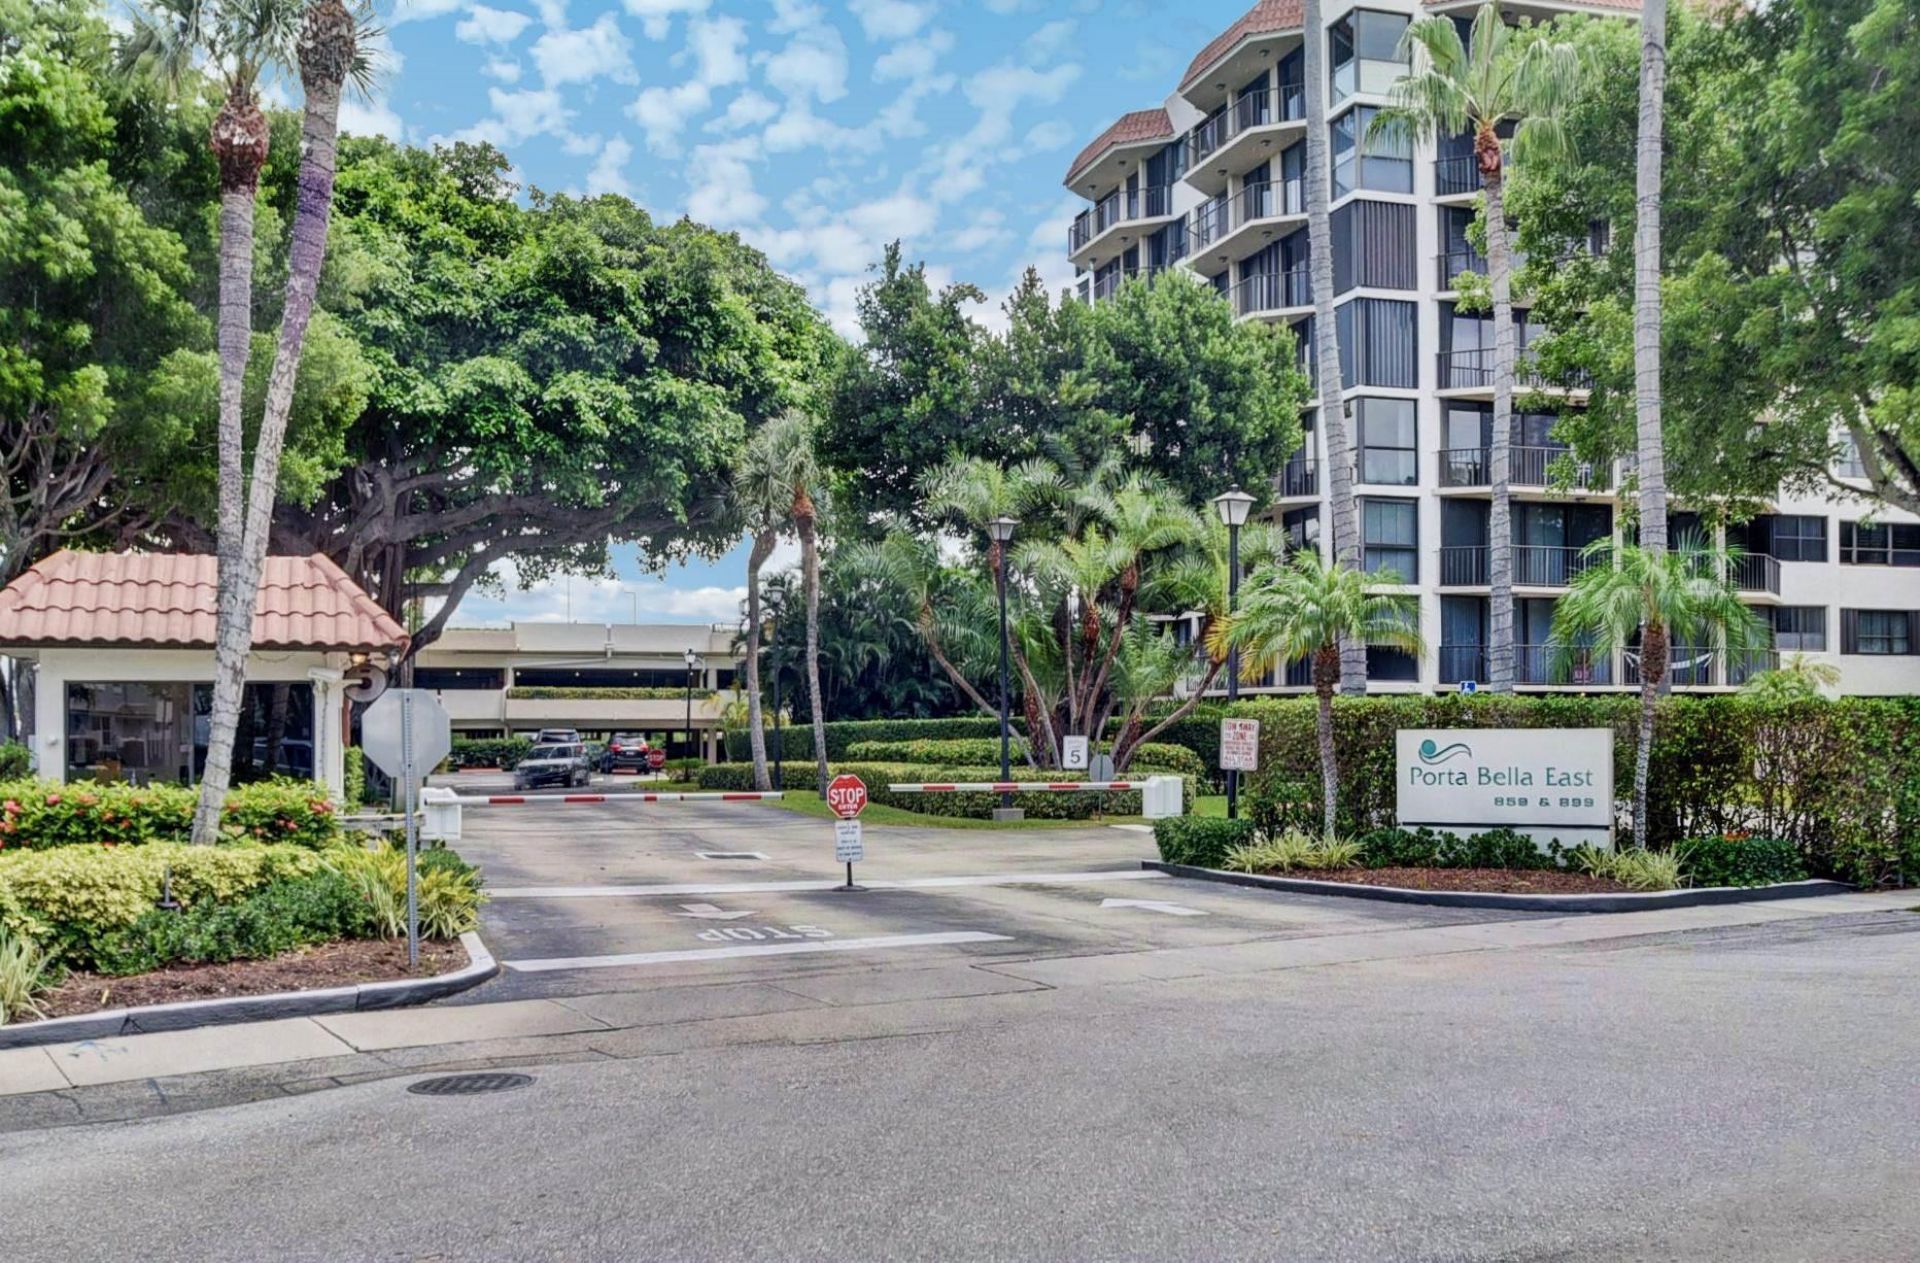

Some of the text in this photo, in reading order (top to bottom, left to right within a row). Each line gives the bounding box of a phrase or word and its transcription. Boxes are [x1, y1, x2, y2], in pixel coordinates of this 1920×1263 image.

[650, 753, 664, 762] STOP
[1070, 749, 1081, 764] 5
[1410, 766, 1593, 788] Porta Bella East
[829, 787, 864, 805] STOP
[1539, 797, 1550, 807] &
[697, 925, 834, 942] STOP
